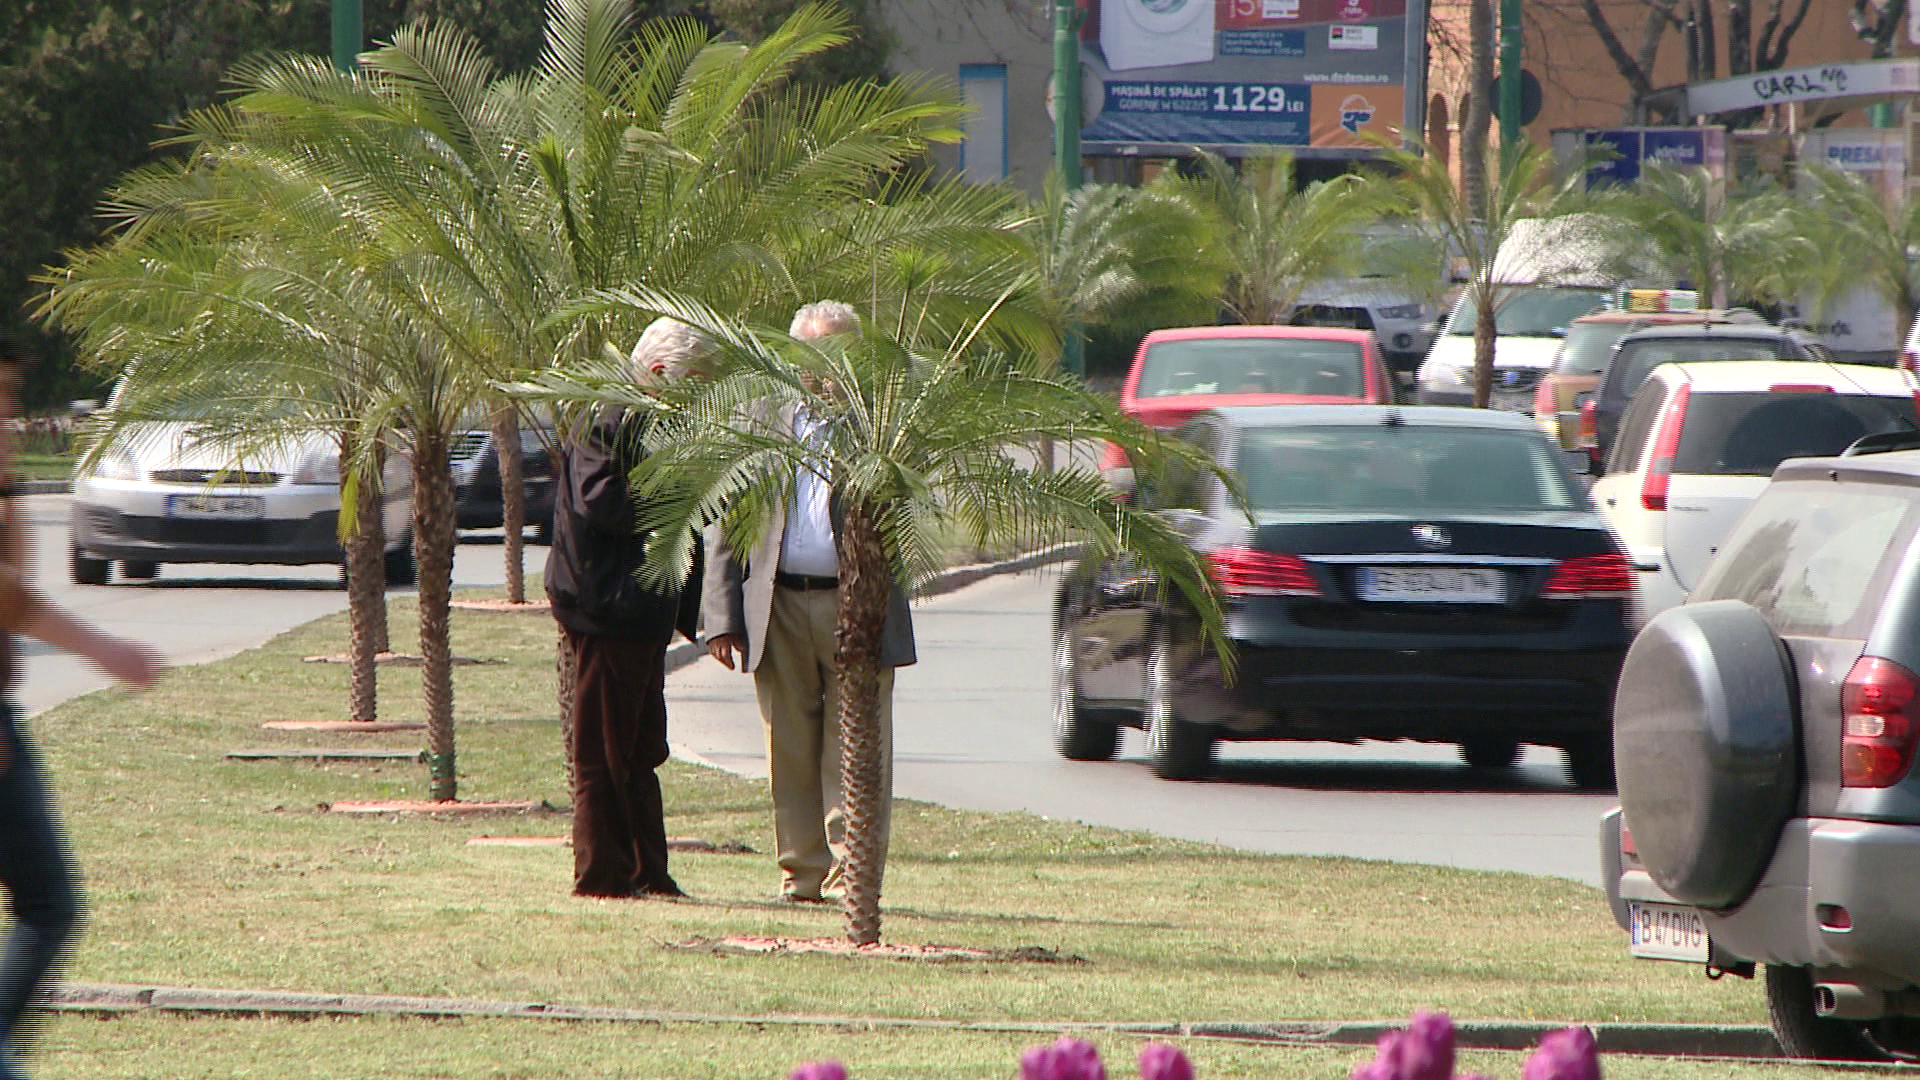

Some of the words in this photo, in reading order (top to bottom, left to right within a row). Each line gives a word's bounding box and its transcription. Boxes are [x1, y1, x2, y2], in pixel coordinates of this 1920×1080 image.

[1213, 86, 1285, 112] 1129
[1753, 73, 1827, 99] CARL
[1286, 101, 1304, 113] LEI
[1642, 910, 1652, 944] B
[1655, 911, 1670, 945] 47
[1672, 913, 1702, 948] DVG
